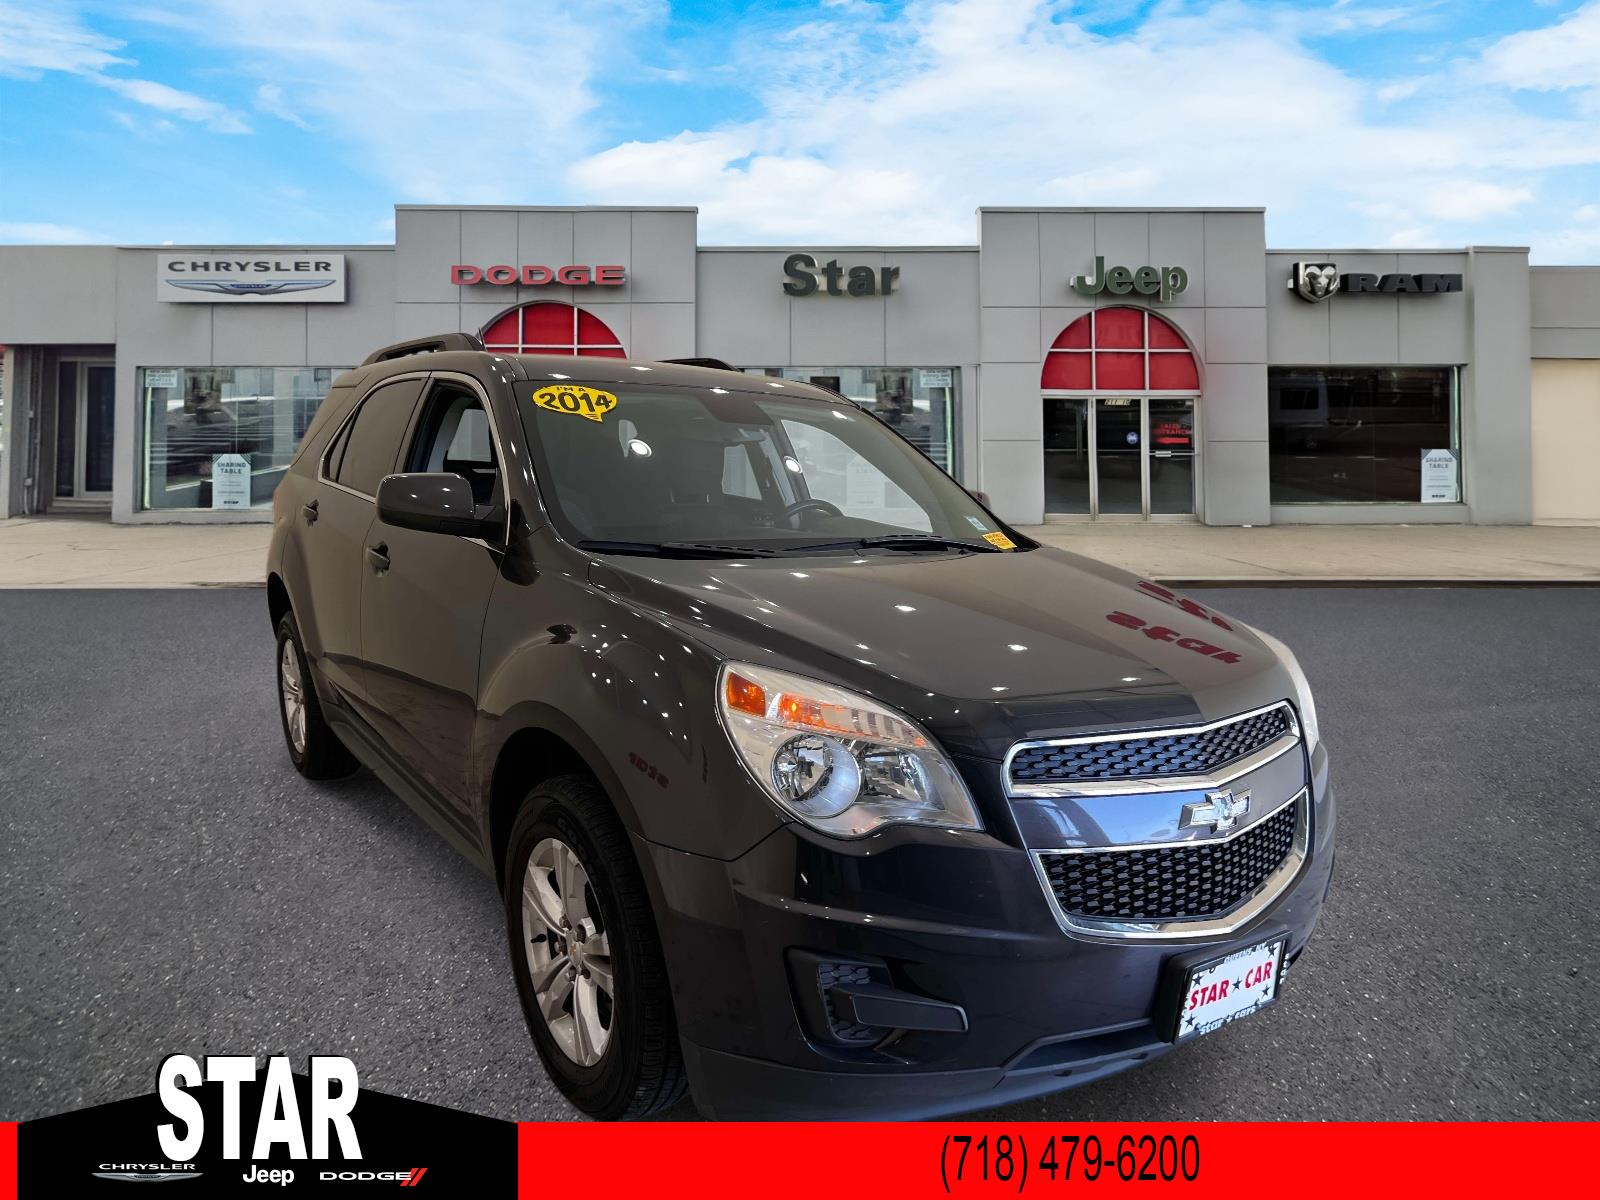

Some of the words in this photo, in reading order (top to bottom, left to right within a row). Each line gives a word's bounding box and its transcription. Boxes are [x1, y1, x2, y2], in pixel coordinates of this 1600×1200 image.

[167, 261, 332, 272] CHRYSLER
[451, 265, 626, 286] DODGE
[783, 253, 900, 297] Star
[1071, 256, 1188, 302] Jeep
[1340, 273, 1463, 292] RAM
[539, 392, 613, 412] 2014
[1188, 979, 1230, 1011] STAR
[1244, 961, 1272, 989] CAR
